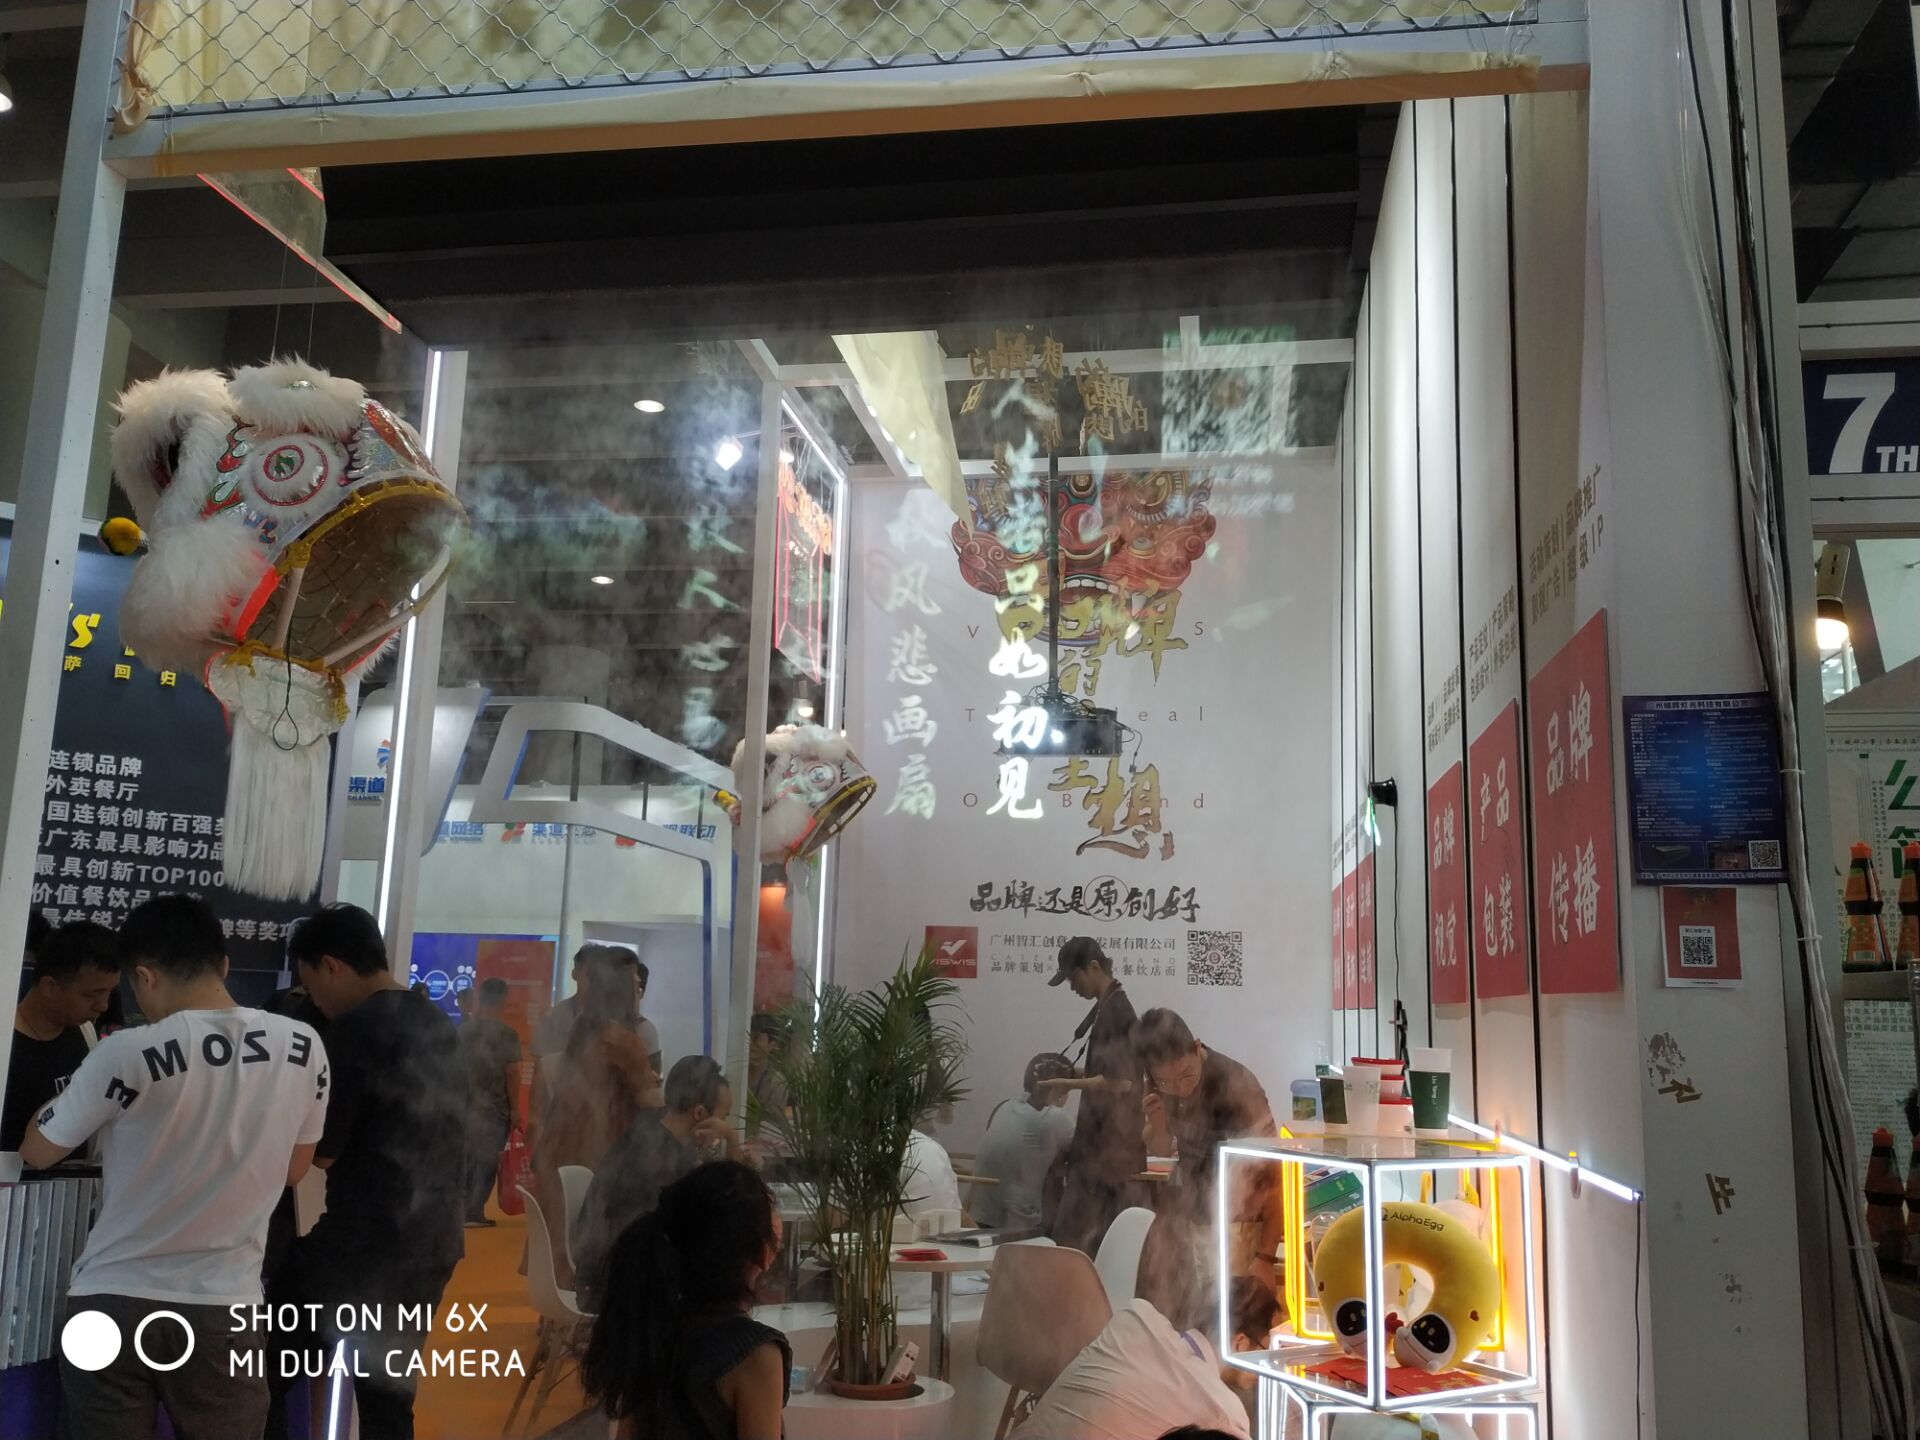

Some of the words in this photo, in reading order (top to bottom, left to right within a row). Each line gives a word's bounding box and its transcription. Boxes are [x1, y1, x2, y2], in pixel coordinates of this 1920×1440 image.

[50, 750, 143, 778] 连锁品牌
[1546, 680, 1593, 796] 品牌
[46, 774, 139, 801] 外卖餐厅
[1479, 757, 1510, 846] 产品
[38, 828, 225, 861] 广东最具影响力品
[1433, 801, 1456, 870] 品牌
[969, 879, 1201, 922] 品牌还是原创好
[1482, 874, 1515, 958] 包装
[1548, 836, 1601, 944] 传播
[990, 933, 1176, 950] 广州智汇创意发展有限公司
[1434, 902, 1457, 967] 视觉
